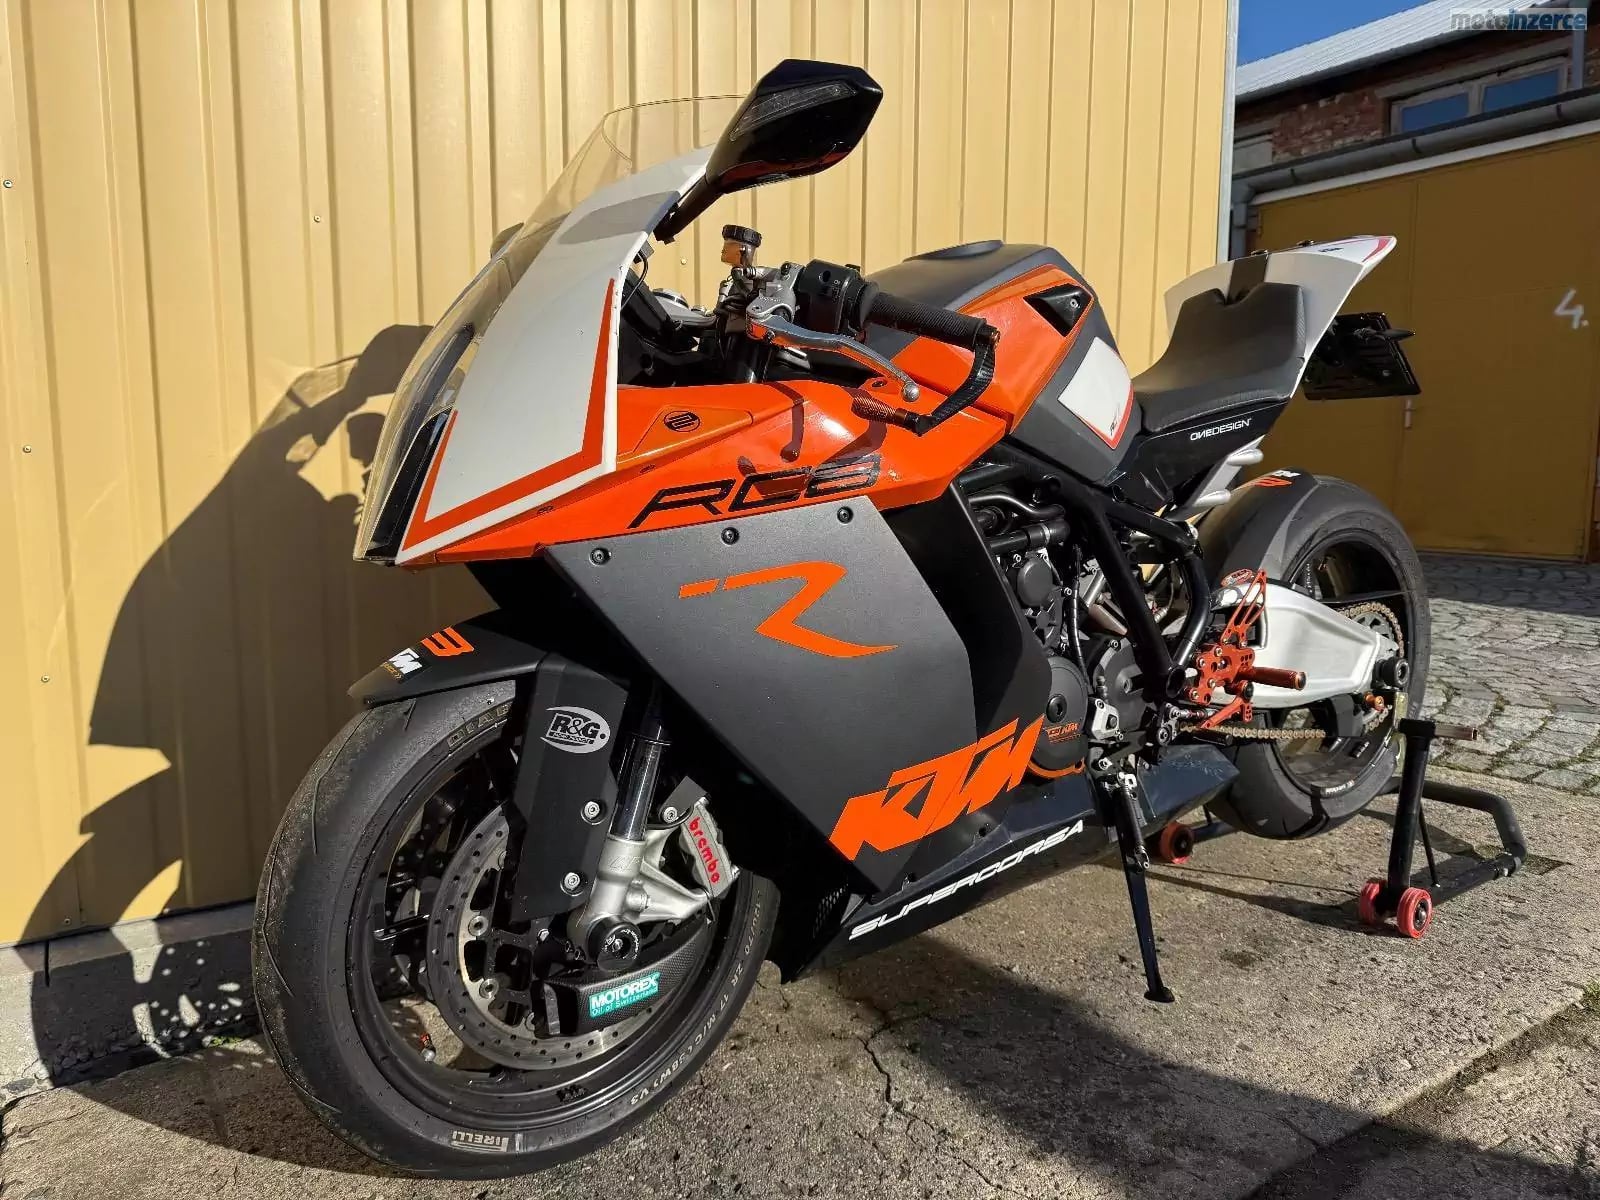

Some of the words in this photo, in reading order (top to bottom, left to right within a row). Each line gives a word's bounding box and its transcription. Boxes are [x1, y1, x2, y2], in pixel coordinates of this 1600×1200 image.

[1190, 418, 1251, 441] ONEDESIGN
[829, 714, 1044, 861] KTM
[688, 816, 721, 884] brembo
[849, 819, 1084, 940] SUPERCORSA
[590, 973, 660, 1009] MOTOREX
[452, 1129, 509, 1152] PIRELLI
